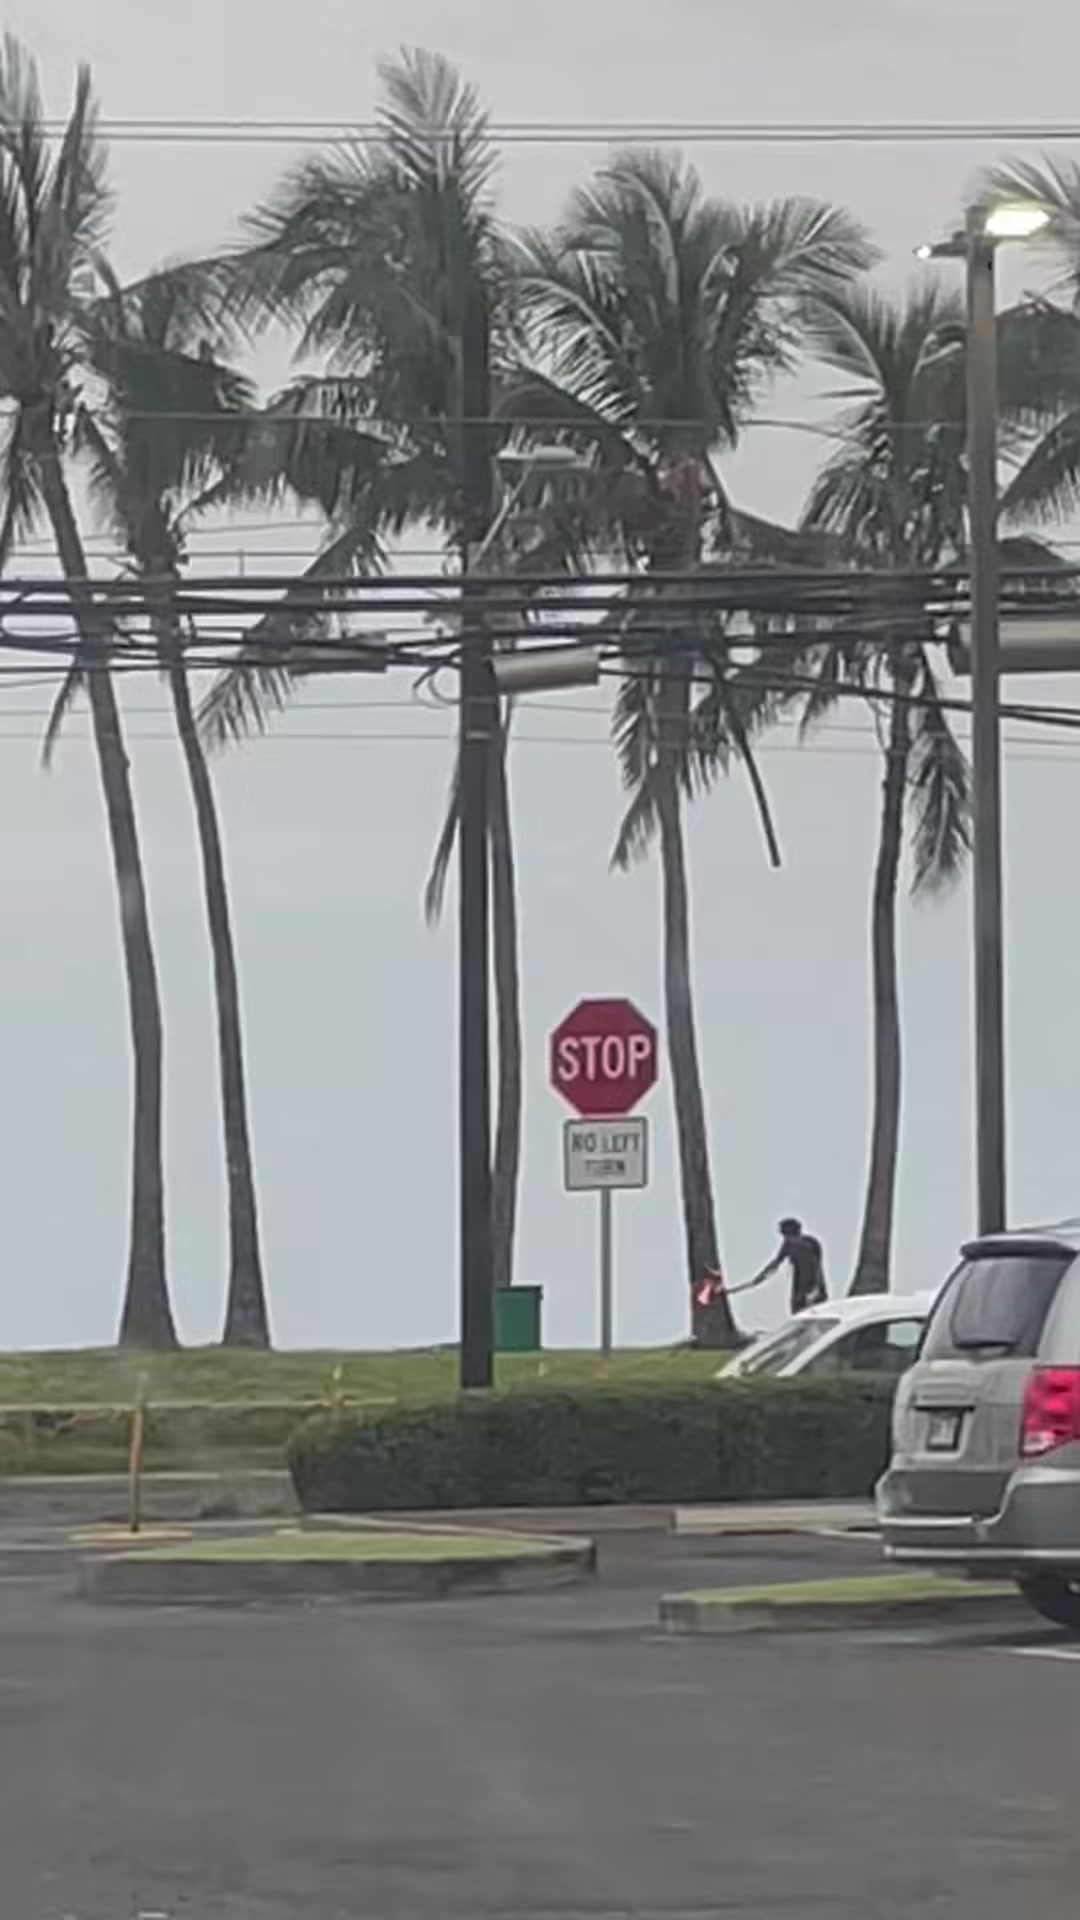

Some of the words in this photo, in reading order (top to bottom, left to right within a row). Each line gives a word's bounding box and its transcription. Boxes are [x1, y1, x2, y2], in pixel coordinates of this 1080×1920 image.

[559, 1035, 651, 1080] STOP
[571, 1132, 597, 1153] NO
[600, 1132, 641, 1153] LEFT
